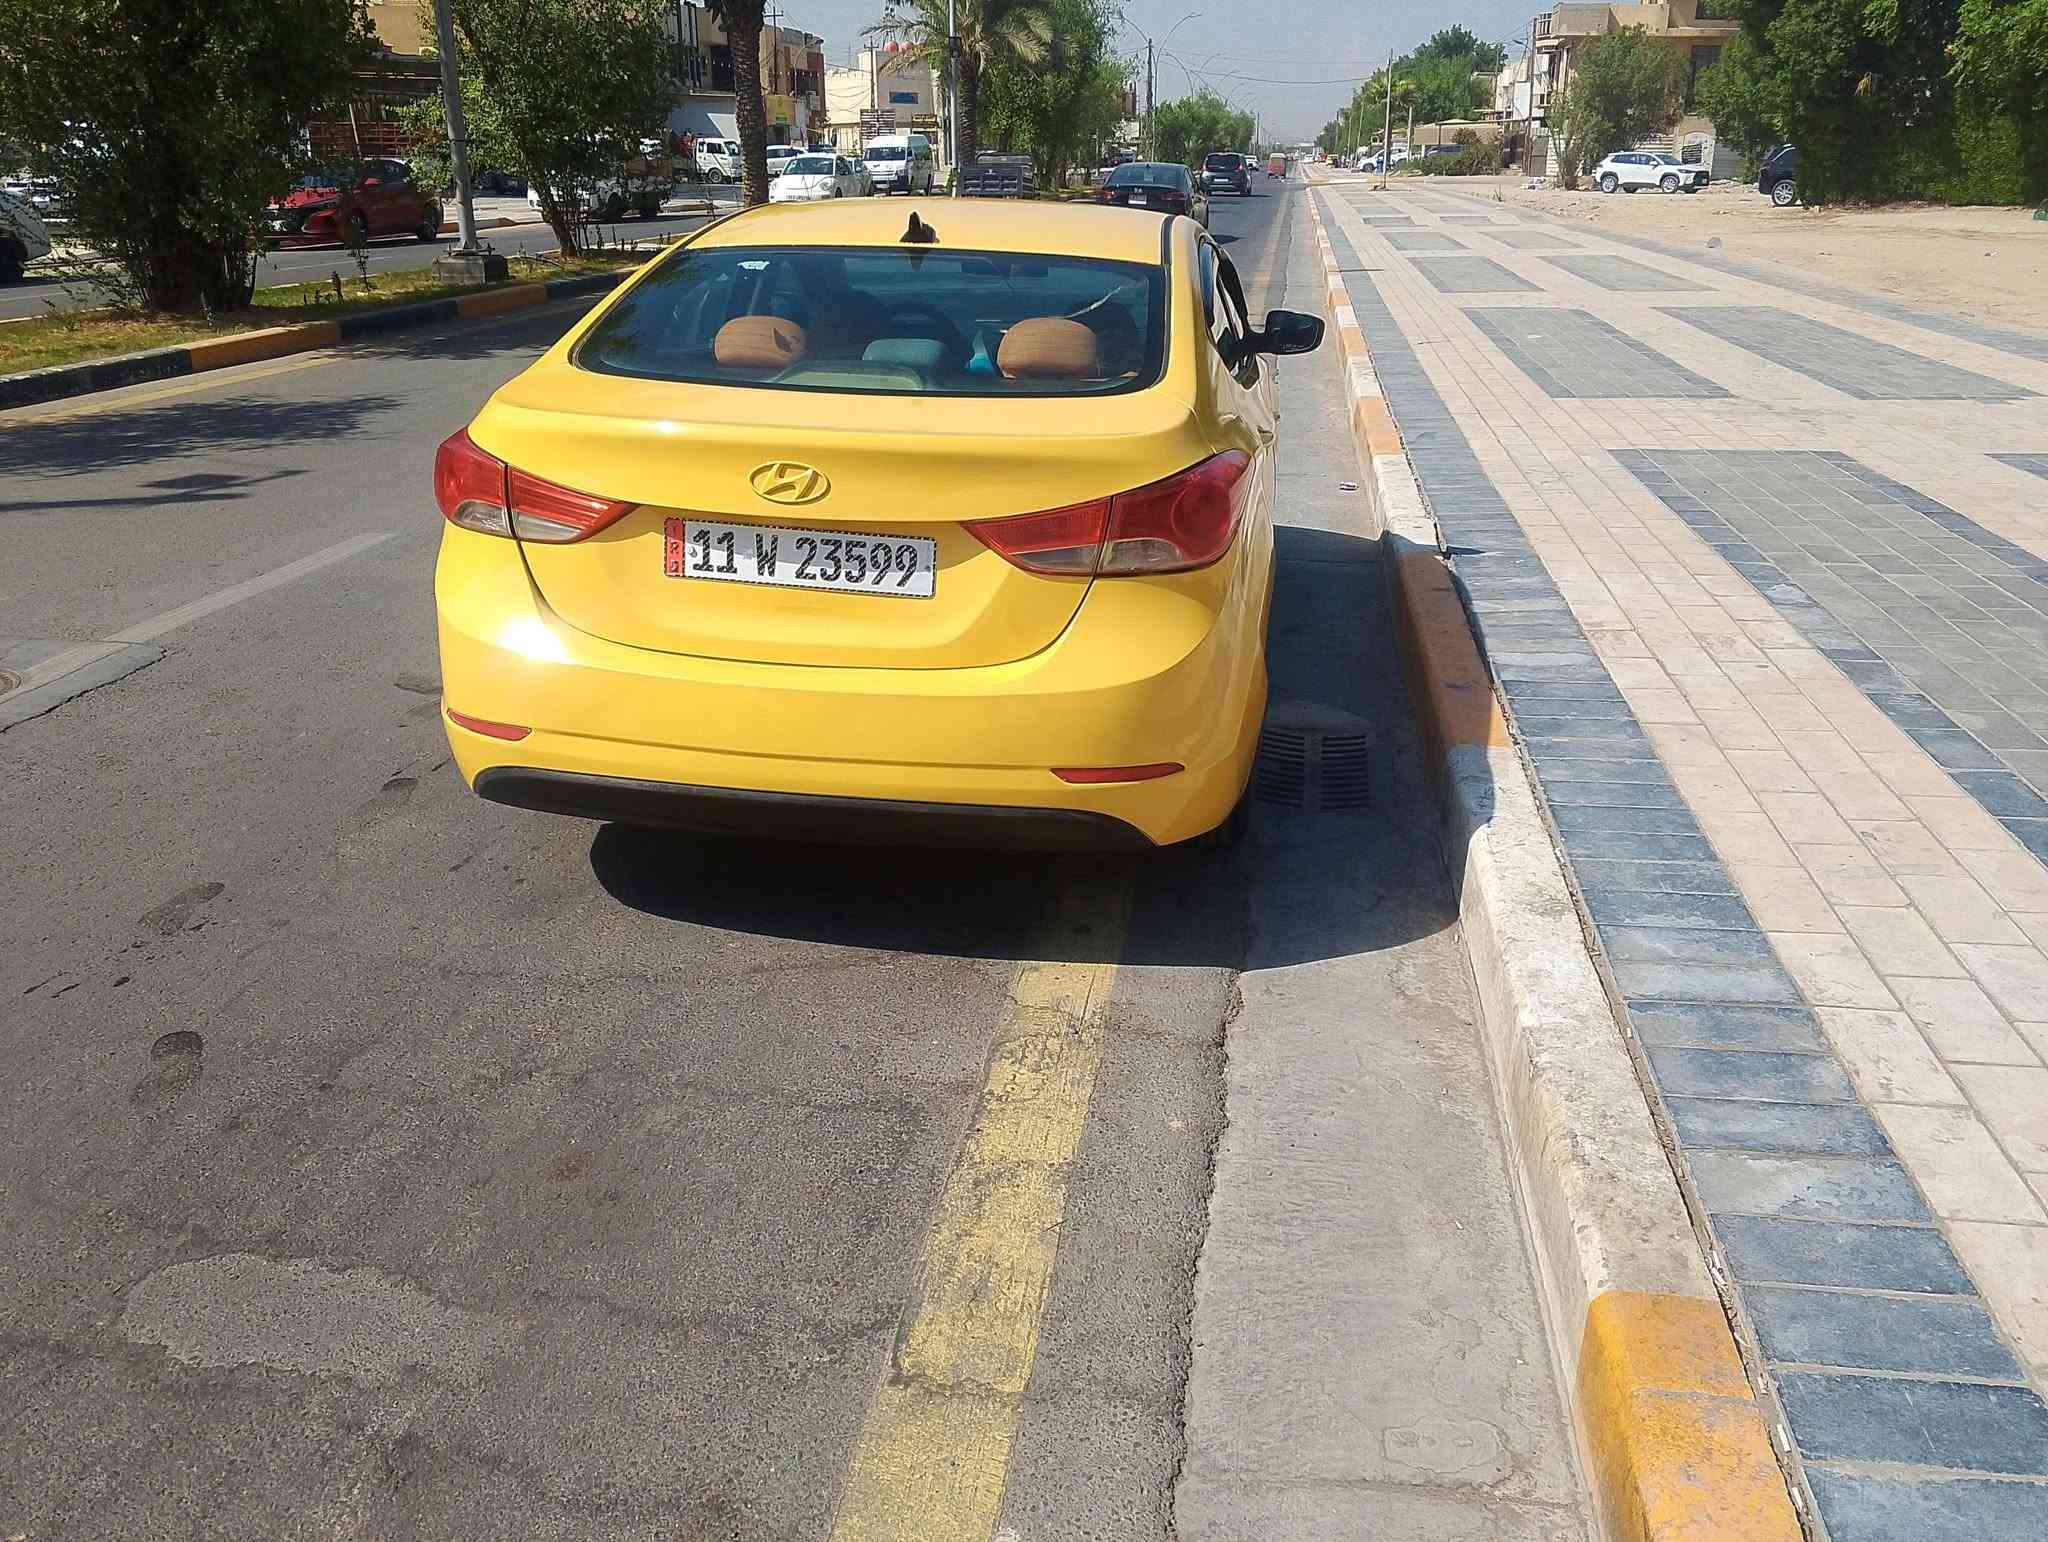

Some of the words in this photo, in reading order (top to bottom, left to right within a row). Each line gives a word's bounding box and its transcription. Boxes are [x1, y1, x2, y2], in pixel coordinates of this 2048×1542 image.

[693, 529, 737, 573] 11
[755, 533, 778, 576] W
[796, 537, 917, 586] 23599
